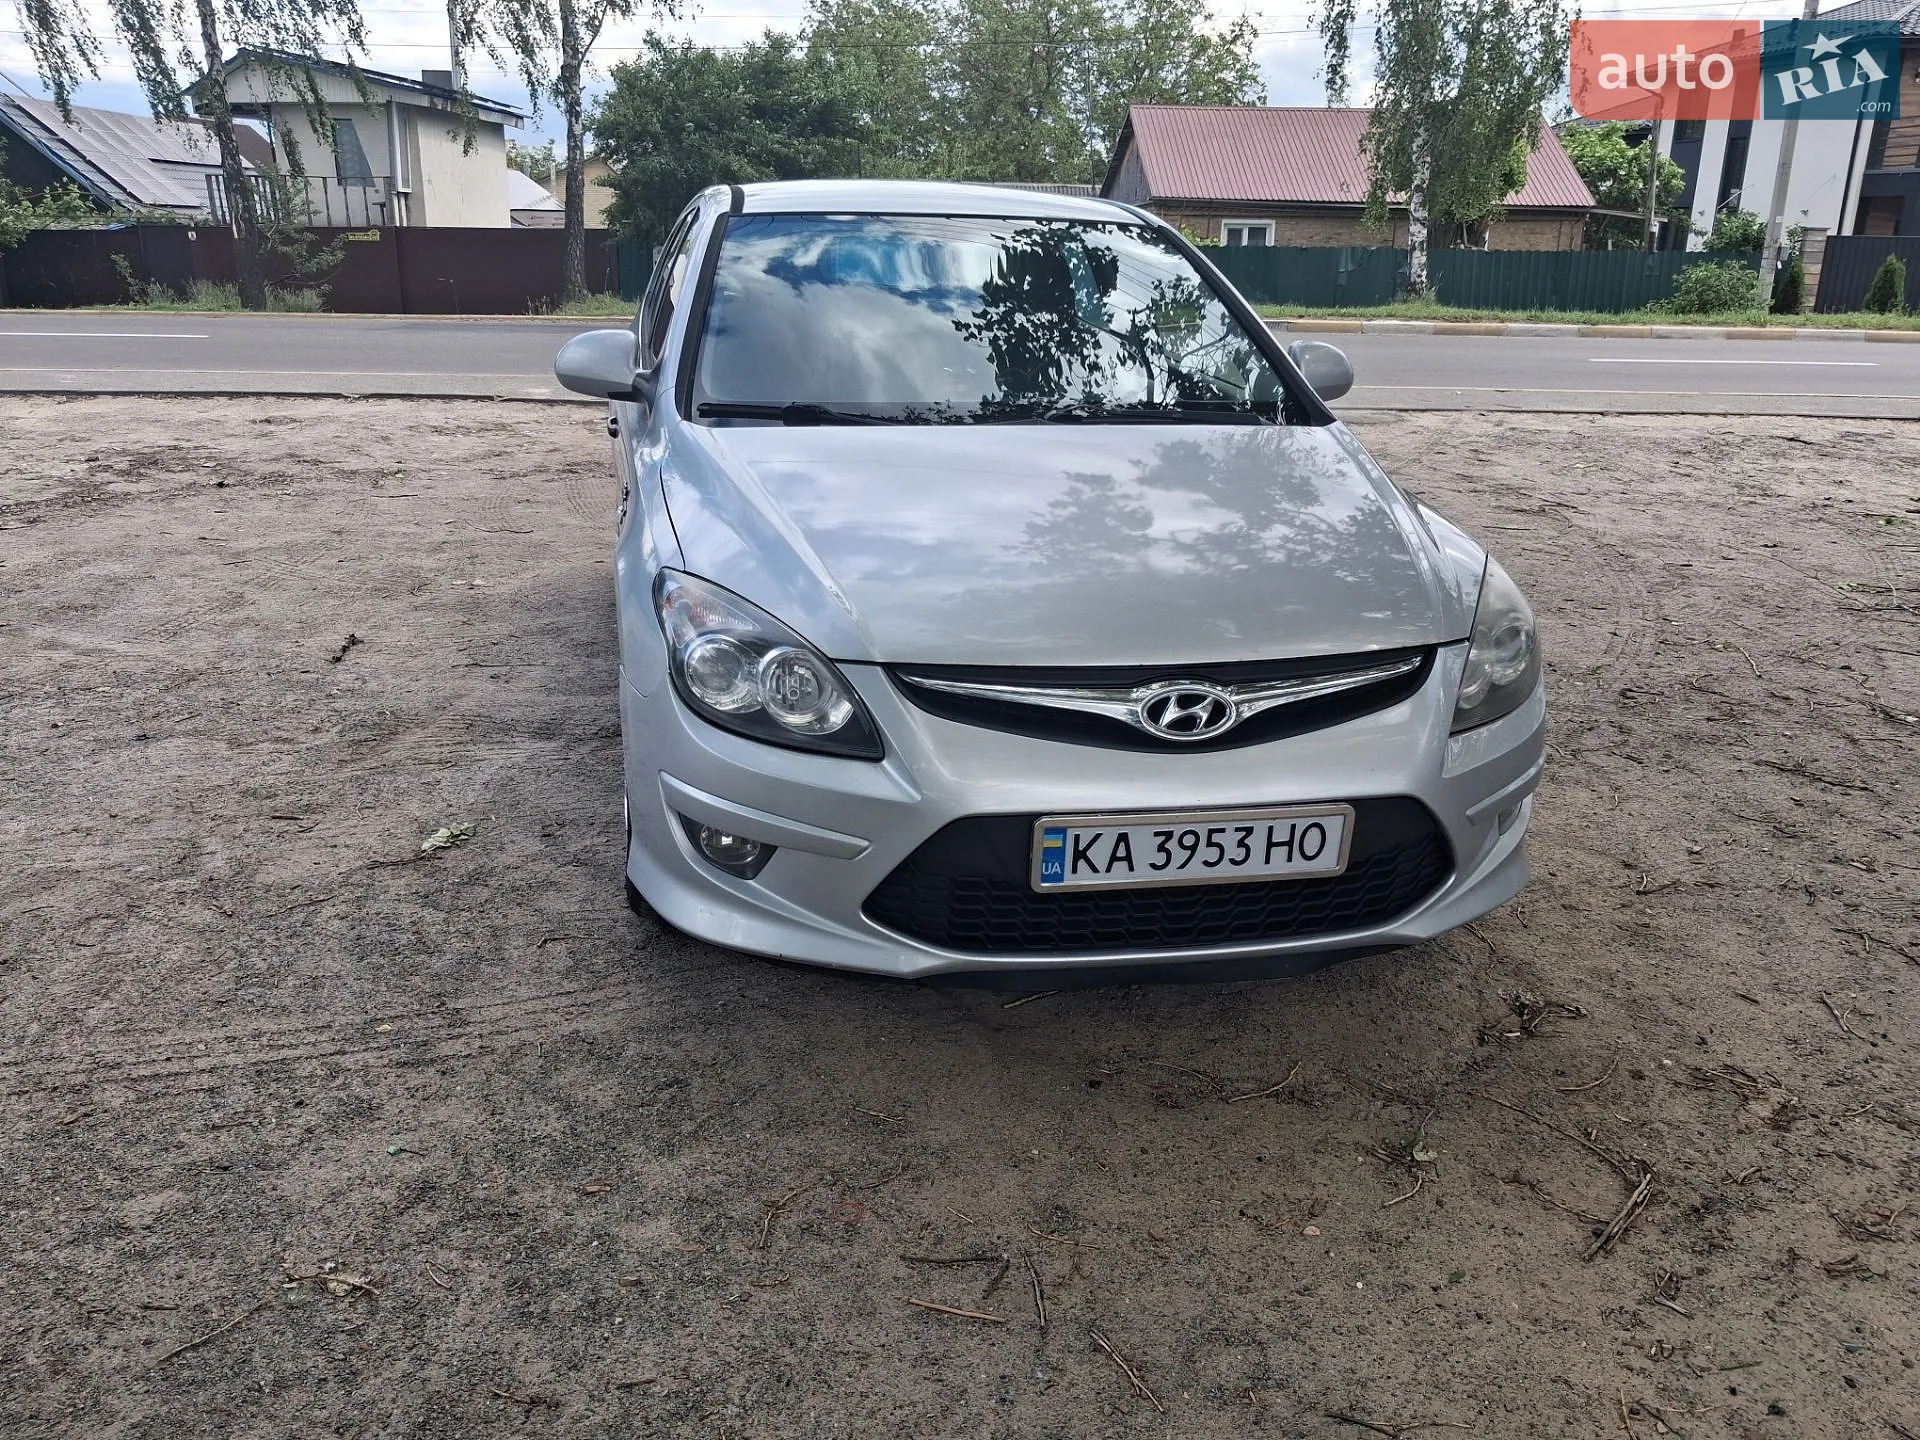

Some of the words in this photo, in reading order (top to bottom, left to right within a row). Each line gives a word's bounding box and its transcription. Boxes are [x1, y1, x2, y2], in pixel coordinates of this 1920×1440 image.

[1071, 832, 1135, 875] KA
[1148, 826, 1255, 871] 3953
[1264, 822, 1328, 865] HO
[1042, 862, 1061, 875] UA
